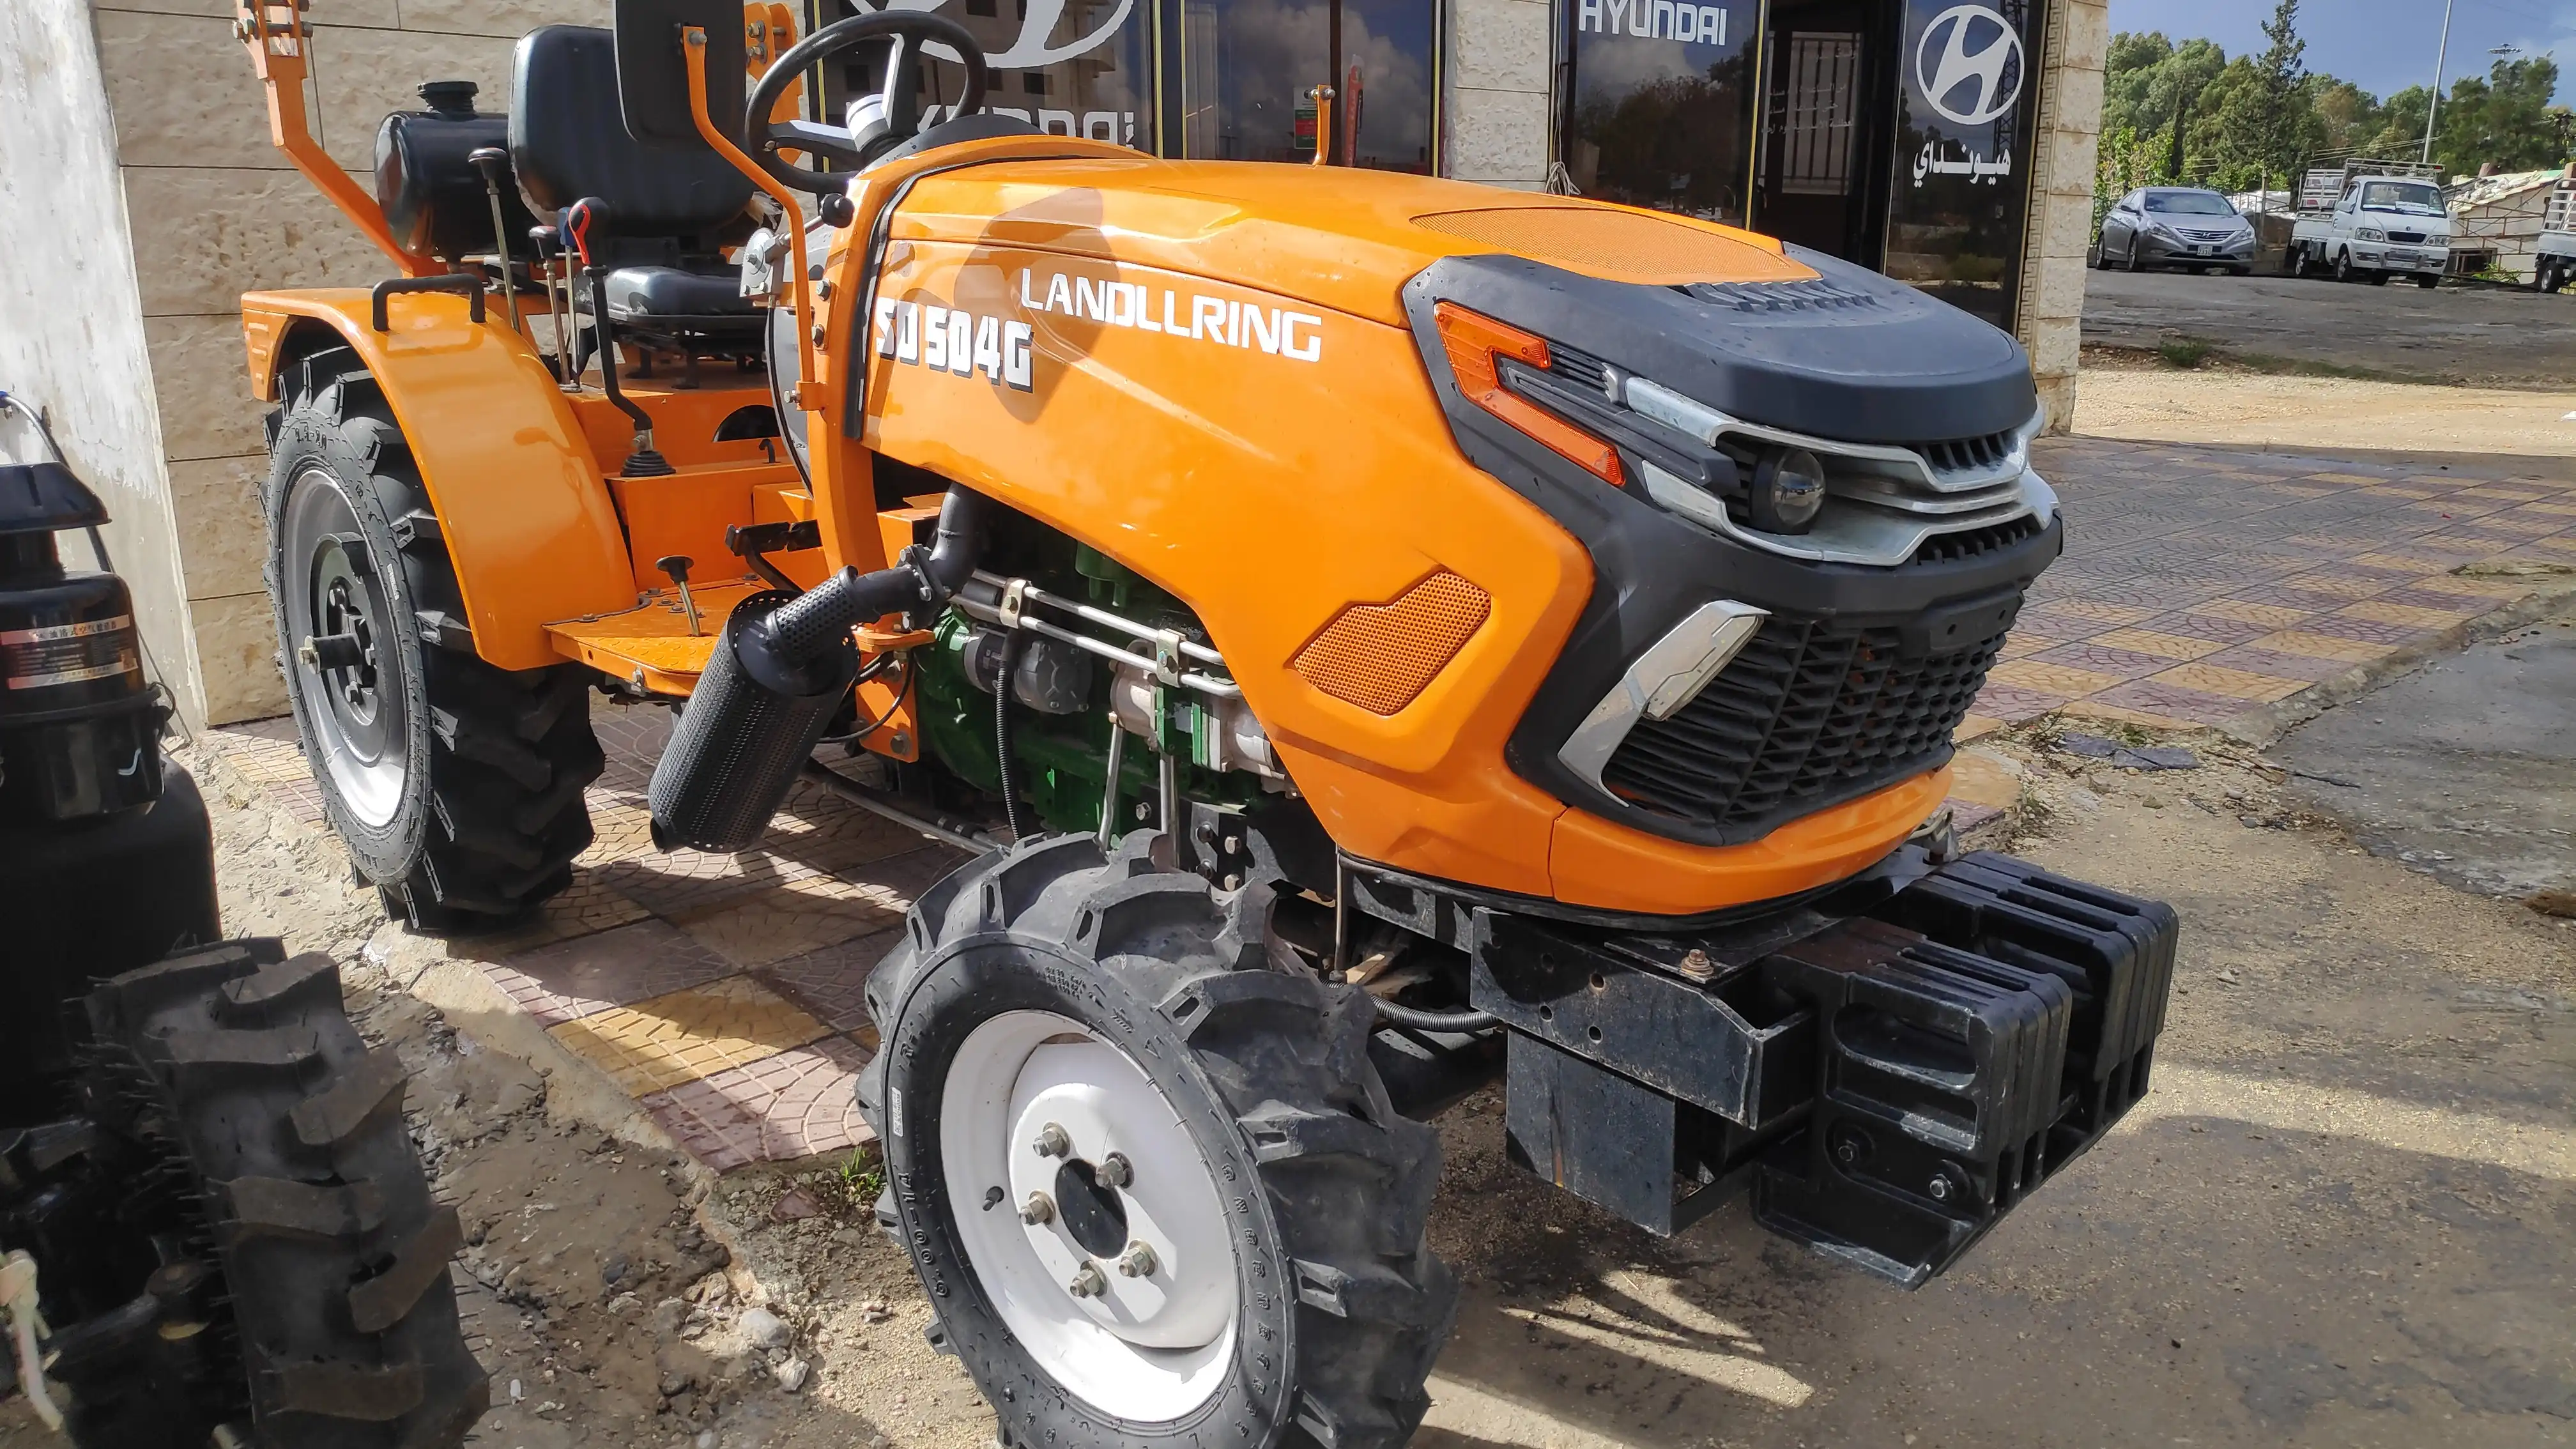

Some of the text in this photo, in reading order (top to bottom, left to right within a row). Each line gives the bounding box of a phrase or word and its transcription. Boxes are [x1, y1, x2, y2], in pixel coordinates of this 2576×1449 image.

[1578, 0, 1727, 46] HYUNDAI
[1913, 139, 2011, 188] هيونداي
[876, 296, 1034, 394] SD 504G
[1021, 268, 1322, 363] LANDLLRING
